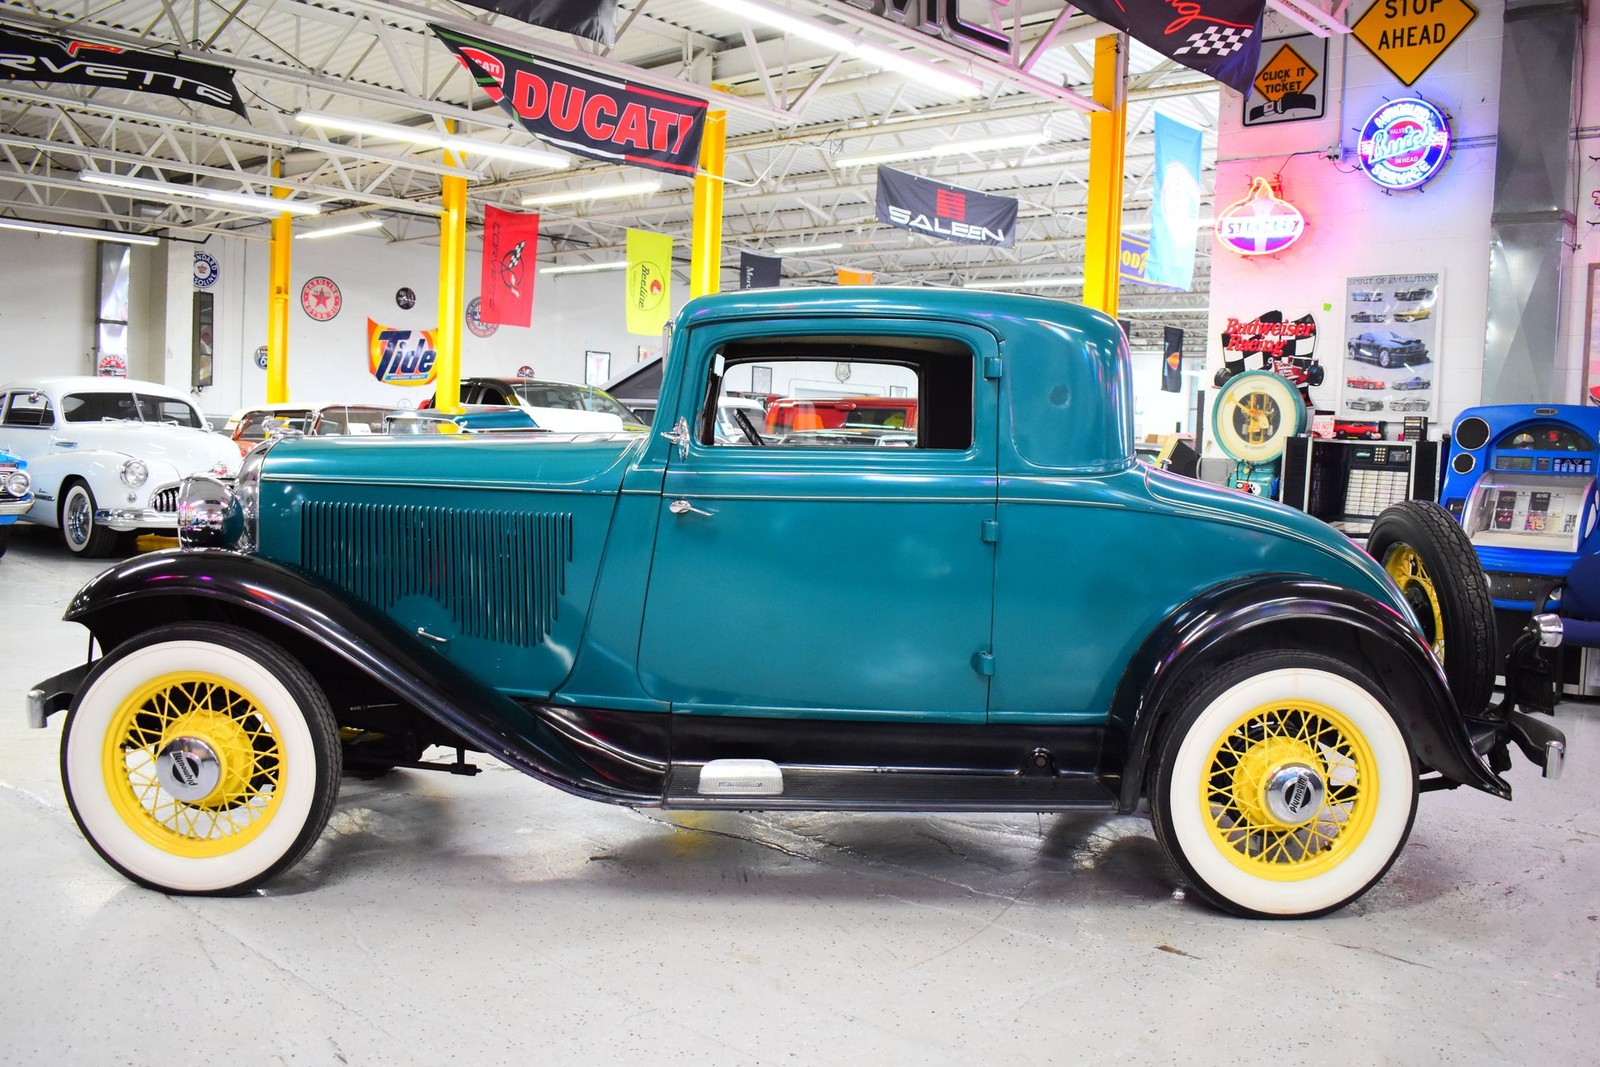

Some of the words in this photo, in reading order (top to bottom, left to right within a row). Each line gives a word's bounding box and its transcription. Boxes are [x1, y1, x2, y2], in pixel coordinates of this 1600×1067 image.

[1385, 0, 1441, 19] STOP
[1378, 23, 1446, 51] AHEAD
[472, 58, 501, 75] CATI
[1262, 69, 1291, 82] CLICK
[1296, 66, 1306, 77] IT
[1265, 80, 1302, 94] TICKET
[512, 69, 694, 155] DUCATI
[1402, 155, 1419, 164] HEAD
[888, 205, 1005, 242] SALEEN
[489, 221, 501, 311] CORVETTE
[638, 264, 651, 309] Beeline
[1347, 278, 1373, 286] SPIRIT
[1376, 277, 1386, 285] OF
[1388, 275, 1439, 284] EVOLUTION
[1224, 317, 1317, 337] Budweiser
[375, 330, 437, 382] Tide
[1226, 334, 1288, 357] Racing
